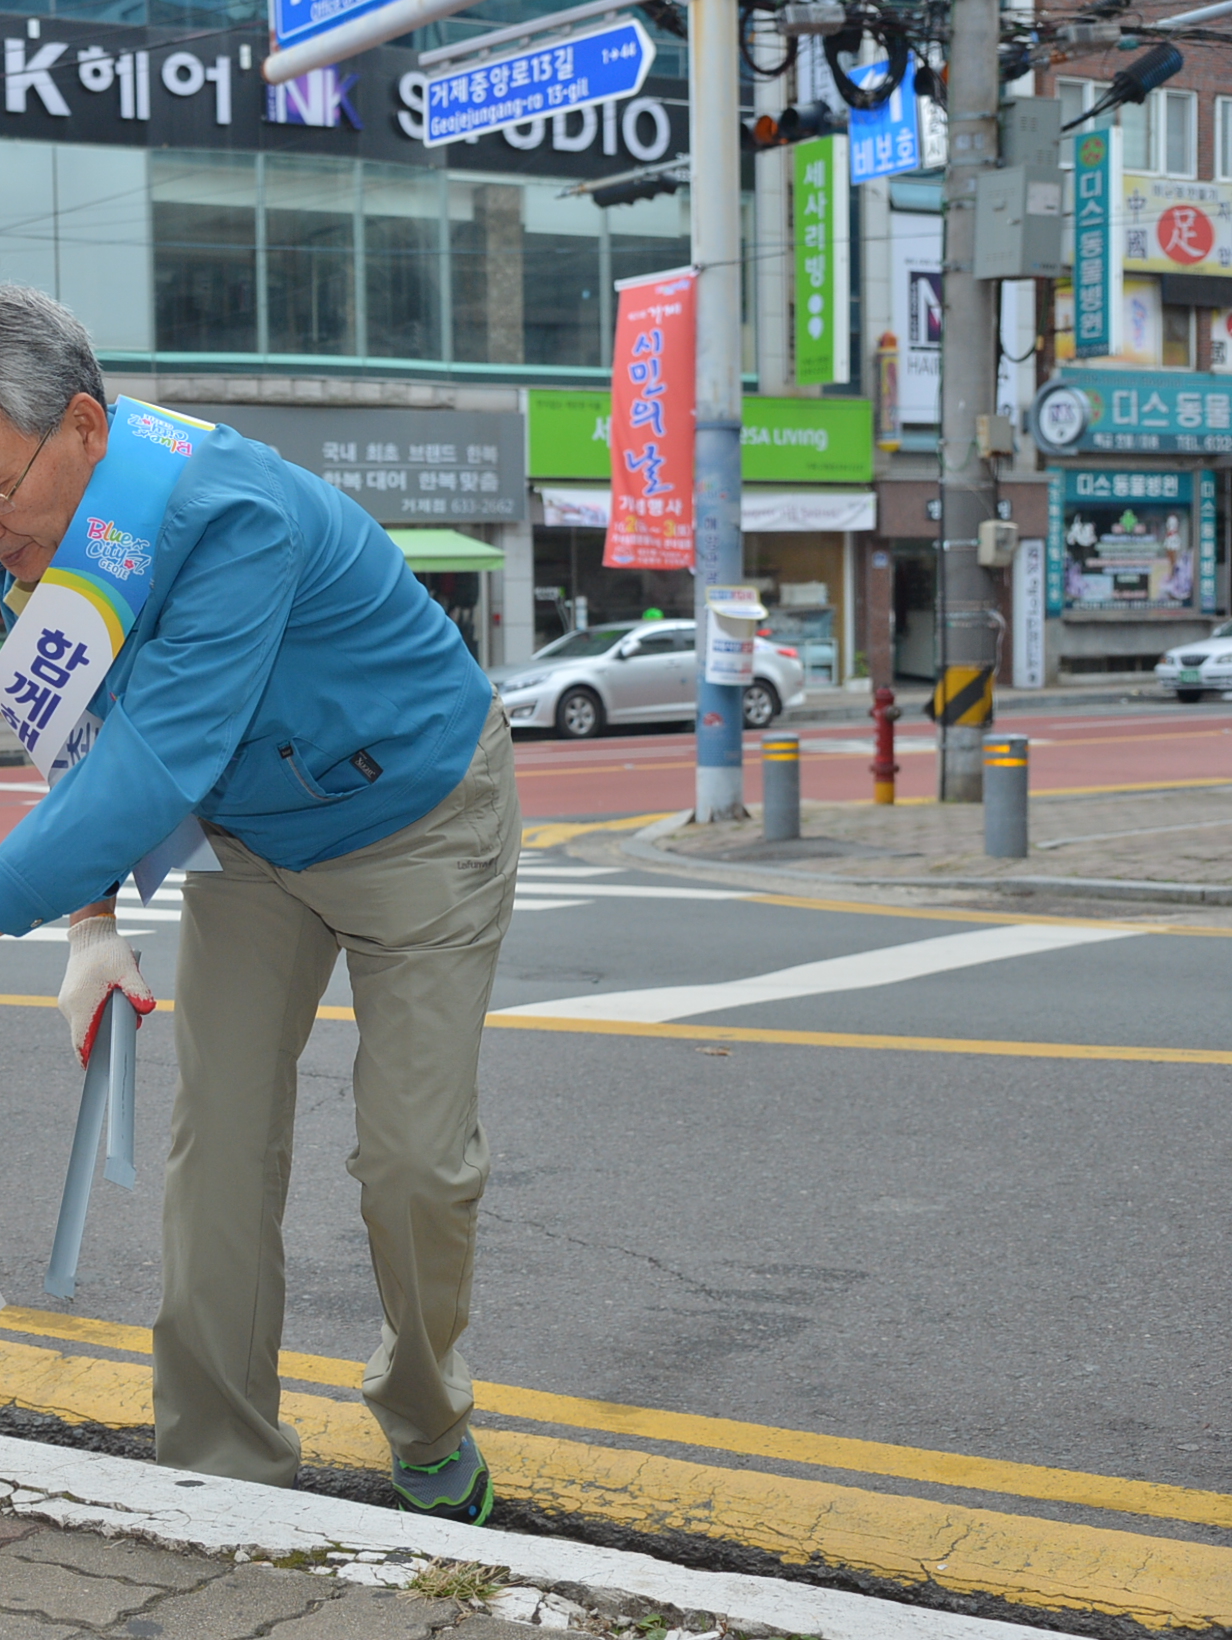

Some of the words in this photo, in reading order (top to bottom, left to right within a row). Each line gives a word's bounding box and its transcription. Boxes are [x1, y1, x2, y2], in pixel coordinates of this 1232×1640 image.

[430, 47, 574, 109] 거제중앙로13길
[853, 126, 915, 176] 비보호
[802, 158, 827, 289] 세사리빙
[1078, 169, 1104, 340] 디스동물병원
[627, 328, 666, 437] 시민의
[150, 434, 193, 457] Blue
[322, 440, 358, 463] 국내
[365, 441, 400, 464] 최초
[408, 443, 458, 464] 브랜드
[466, 444, 499, 465] 한복
[623, 442, 676, 497] 날
[85, 539, 129, 567] City
[87, 516, 133, 547] Blue
[98, 558, 131, 581] GEOJE
